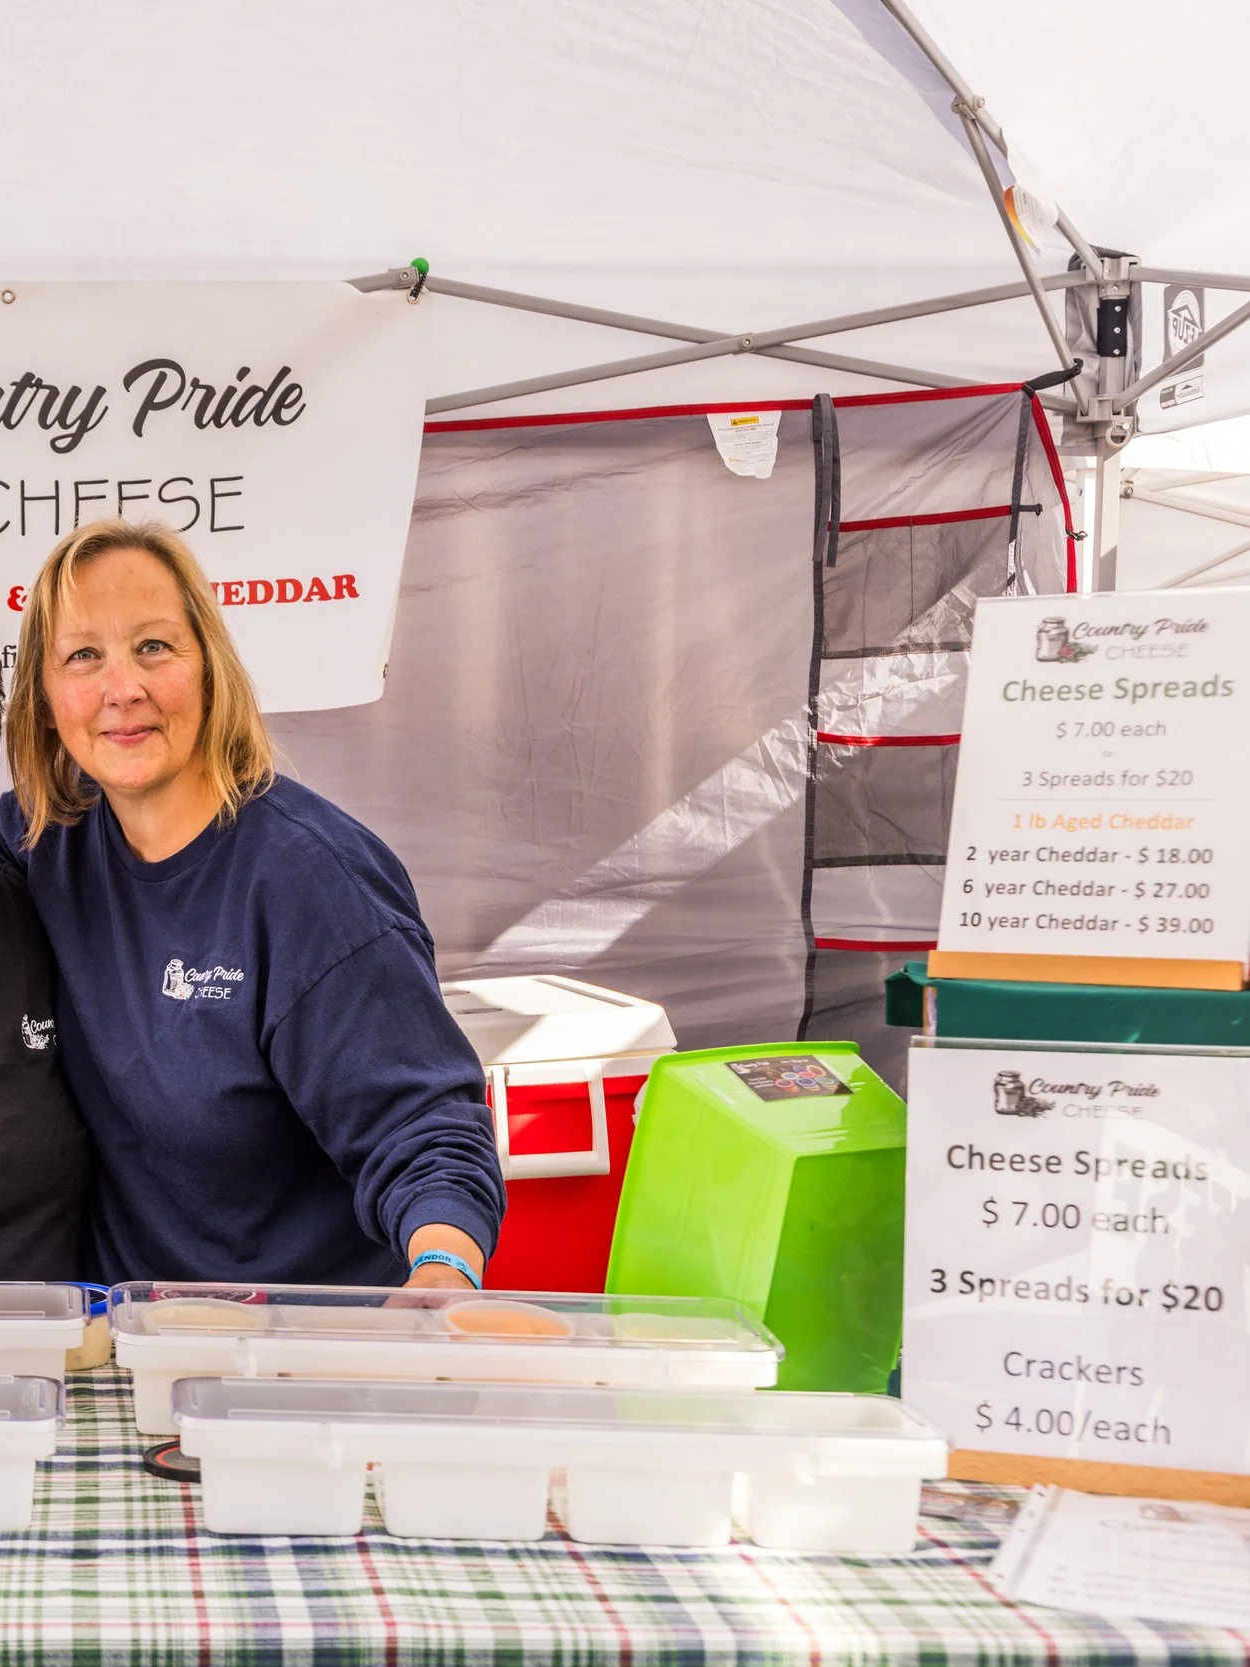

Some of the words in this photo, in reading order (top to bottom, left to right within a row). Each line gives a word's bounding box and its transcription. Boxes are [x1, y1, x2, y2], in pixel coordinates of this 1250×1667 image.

[123, 357, 307, 436] Pride
[211, 574, 360, 606] EDDAR
[1073, 621, 1150, 641] Country
[1154, 618, 1210, 637] Pride
[1105, 643, 1191, 661] CHEESE
[1002, 679, 1105, 702] Cheese
[1114, 674, 1235, 705] Spreads
[1074, 721, 1116, 738] 7.00
[1121, 720, 1167, 738] each
[1022, 771, 1033, 787] 3
[1039, 770, 1115, 790] Spreads
[1121, 770, 1150, 787] for
[1155, 769, 1194, 789] $20
[1013, 814, 1022, 829] 1
[1029, 813, 1047, 829] lb
[1052, 813, 1102, 833] Aged
[1109, 813, 1195, 830] Cheddar
[966, 846, 977, 861] 2
[988, 849, 1030, 865] year
[1036, 846, 1119, 864] Cheddar
[963, 879, 974, 894] 6
[984, 882, 1026, 898] year
[1032, 880, 1115, 897] Cheddar
[959, 912, 981, 928] 10
[987, 915, 1030, 931] year
[1036, 913, 1119, 932] Cheddar
[213, 966, 244, 981] Pride
[1028, 1078, 1103, 1100] Country
[1107, 1080, 1161, 1098] Pride
[1062, 1103, 1144, 1120] CHEESE
[947, 1144, 1062, 1174] Cheese
[1074, 1150, 1209, 1181] Spreads
[1012, 1201, 1081, 1230] 7.00
[1092, 1207, 1169, 1234] each
[929, 1268, 947, 1293] 3
[959, 1270, 1089, 1303] Spreads
[1102, 1278, 1150, 1306] for
[1162, 1280, 1224, 1313] $20
[1003, 1351, 1145, 1387] Crackers
